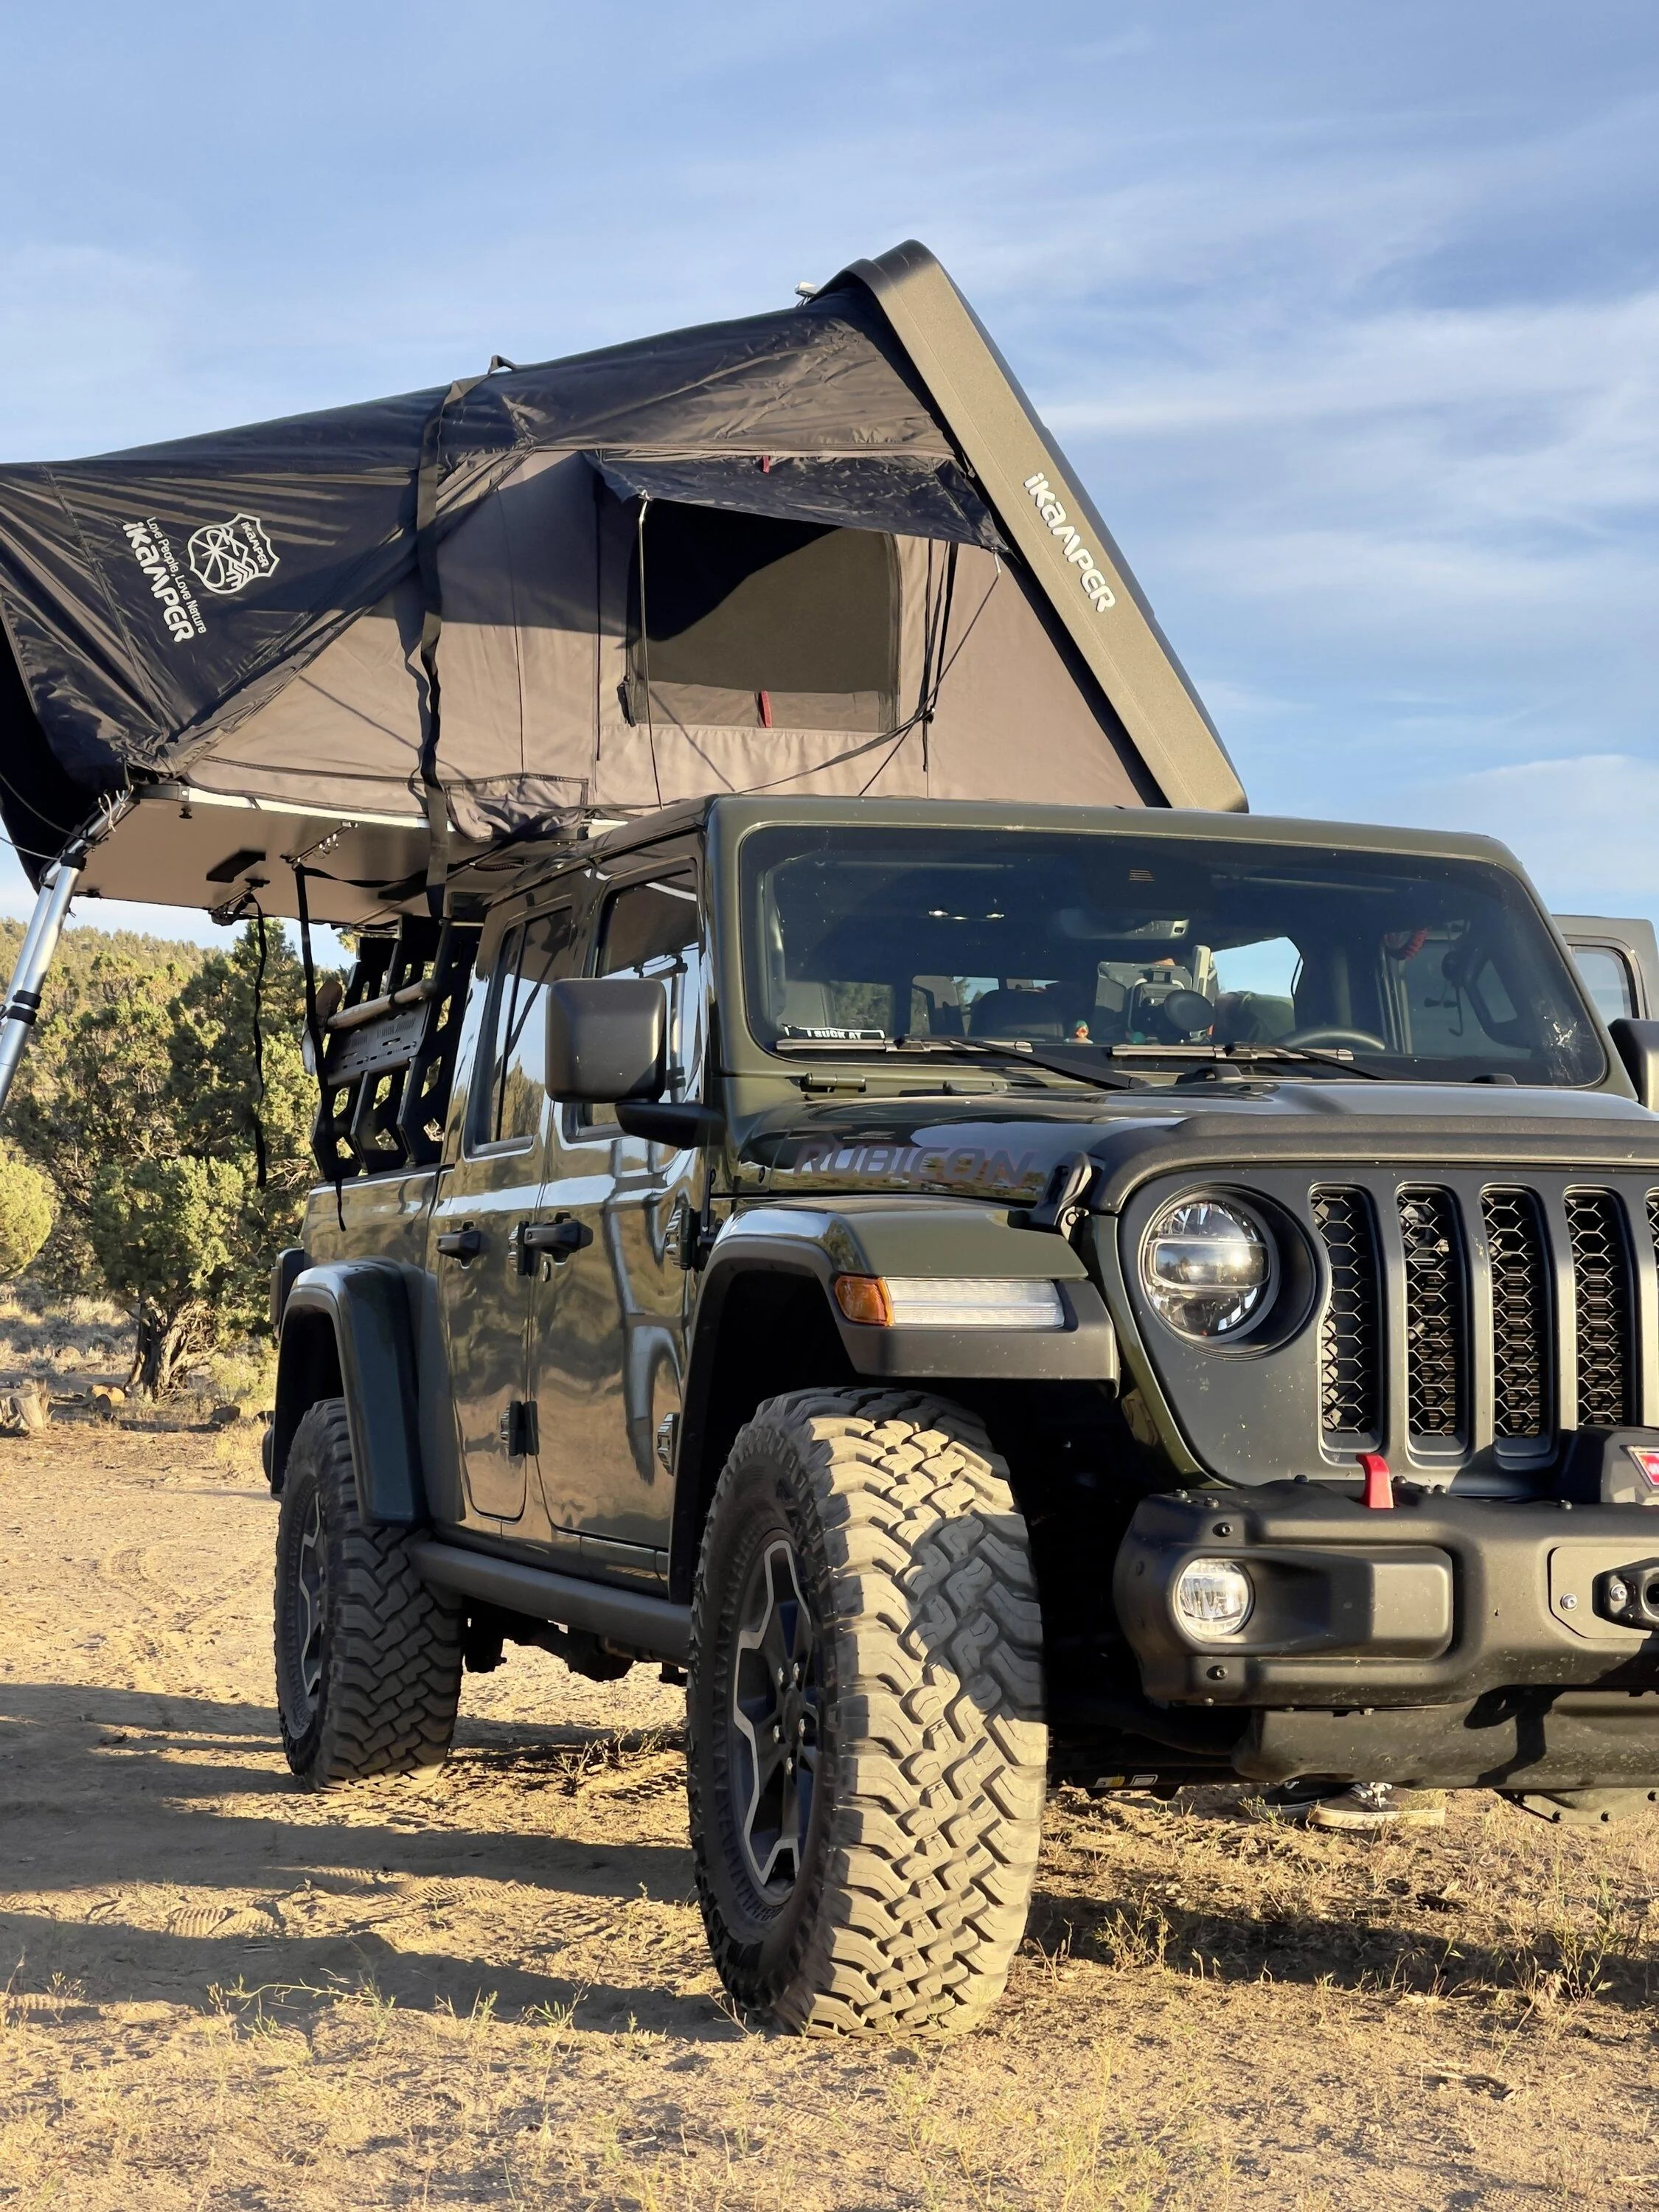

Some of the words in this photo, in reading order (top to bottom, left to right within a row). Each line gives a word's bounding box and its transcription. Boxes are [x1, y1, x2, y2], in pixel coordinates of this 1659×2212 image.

[146, 517, 163, 539] Love
[158, 538, 179, 577] People,
[175, 574, 192, 600] Love
[186, 599, 206, 634] Nature
[793, 1143, 1038, 1184] RUBICON
